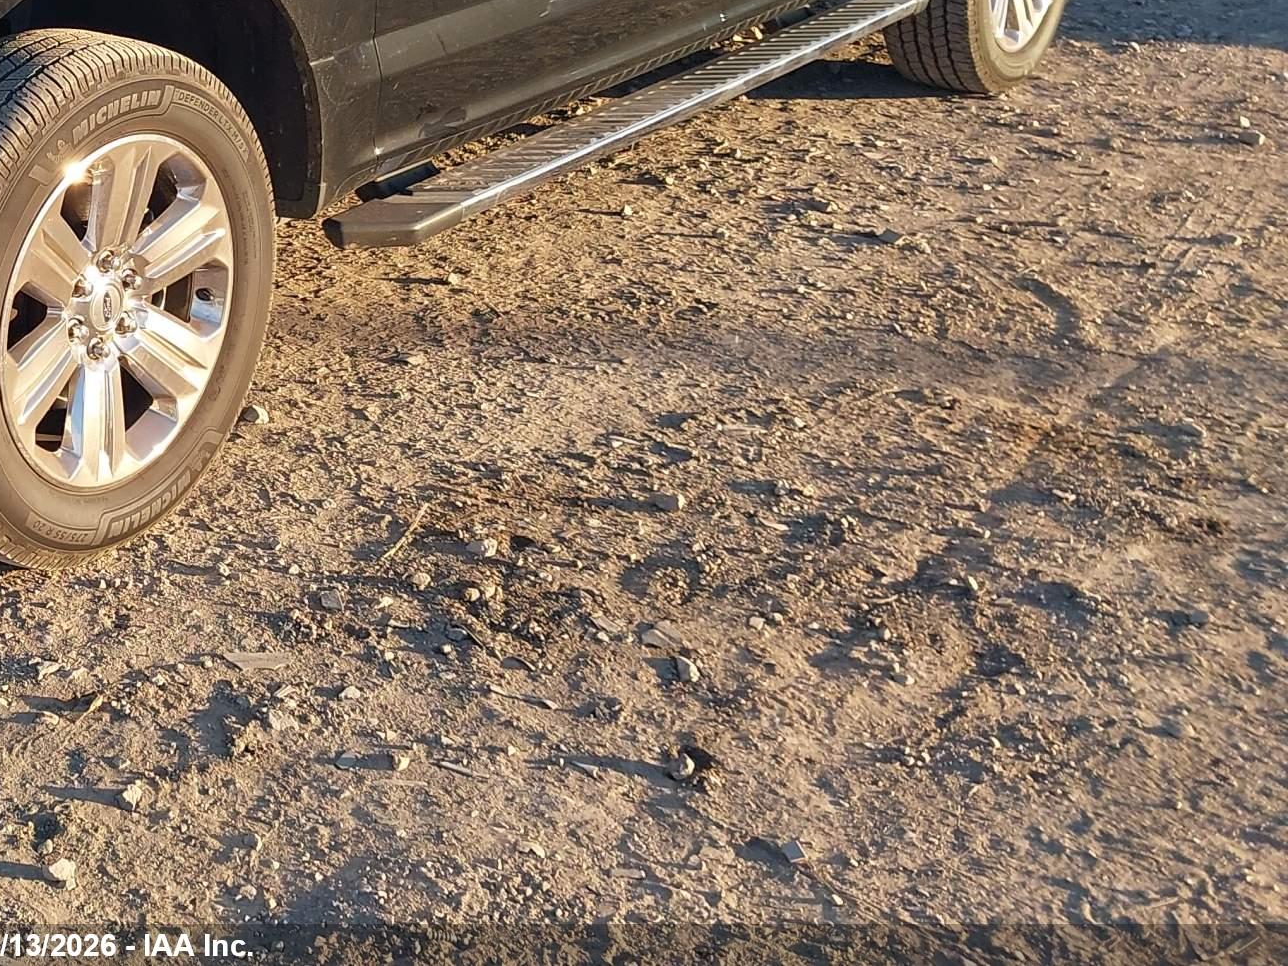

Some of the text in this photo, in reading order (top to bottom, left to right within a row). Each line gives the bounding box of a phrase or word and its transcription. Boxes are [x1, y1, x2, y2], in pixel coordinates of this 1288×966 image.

[71, 88, 163, 145] MICHELIN
[178, 91, 219, 119] DEFENDER
[105, 468, 192, 540] MICHELIN
